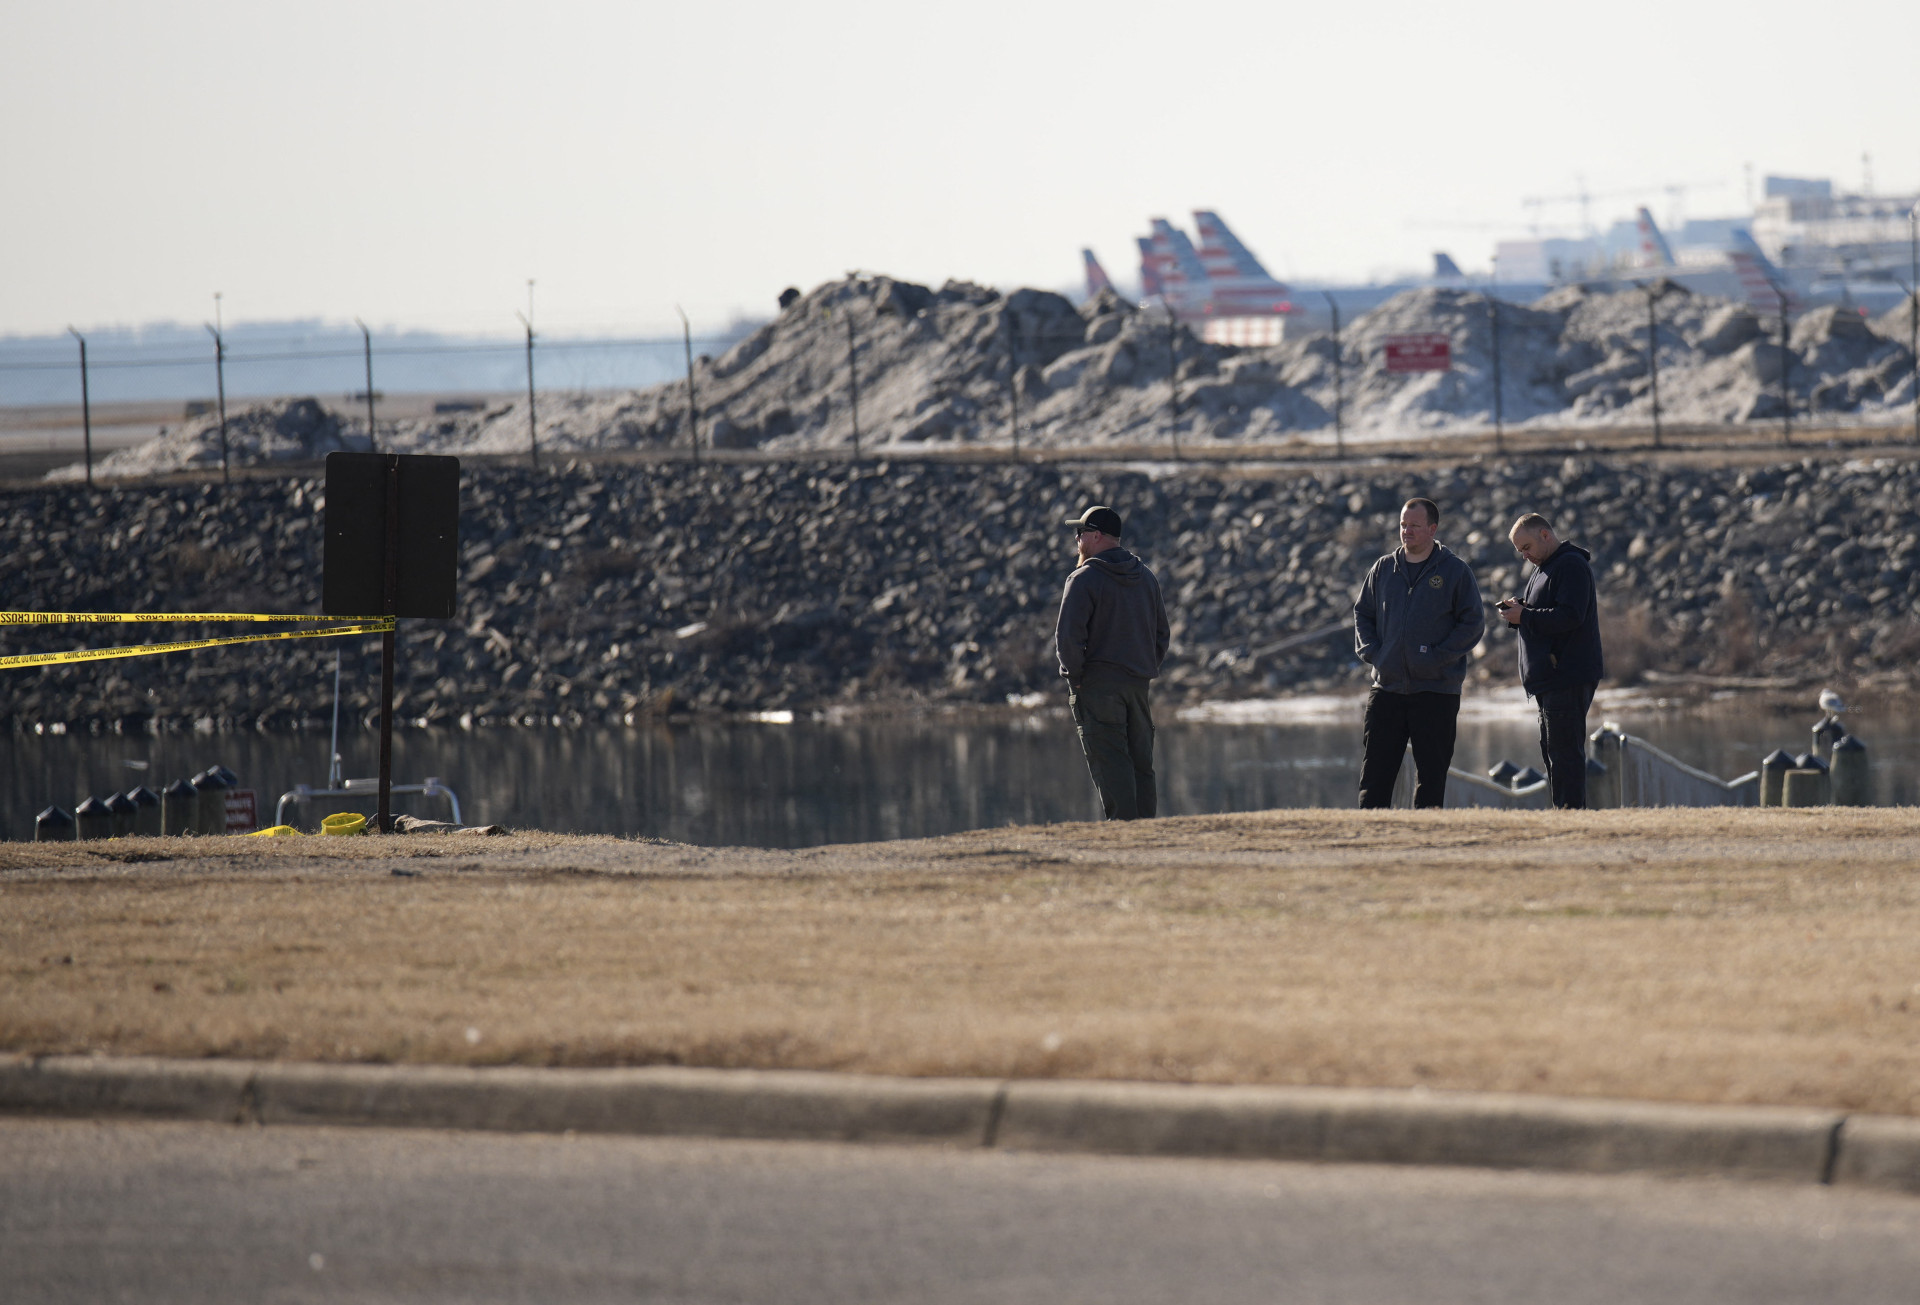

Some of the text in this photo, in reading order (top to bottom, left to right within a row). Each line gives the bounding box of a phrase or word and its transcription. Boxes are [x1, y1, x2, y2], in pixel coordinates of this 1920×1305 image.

[0, 614, 30, 623] CROSS
[32, 614, 48, 623] NOT
[51, 614, 62, 623] DO
[66, 614, 92, 622] SCENE
